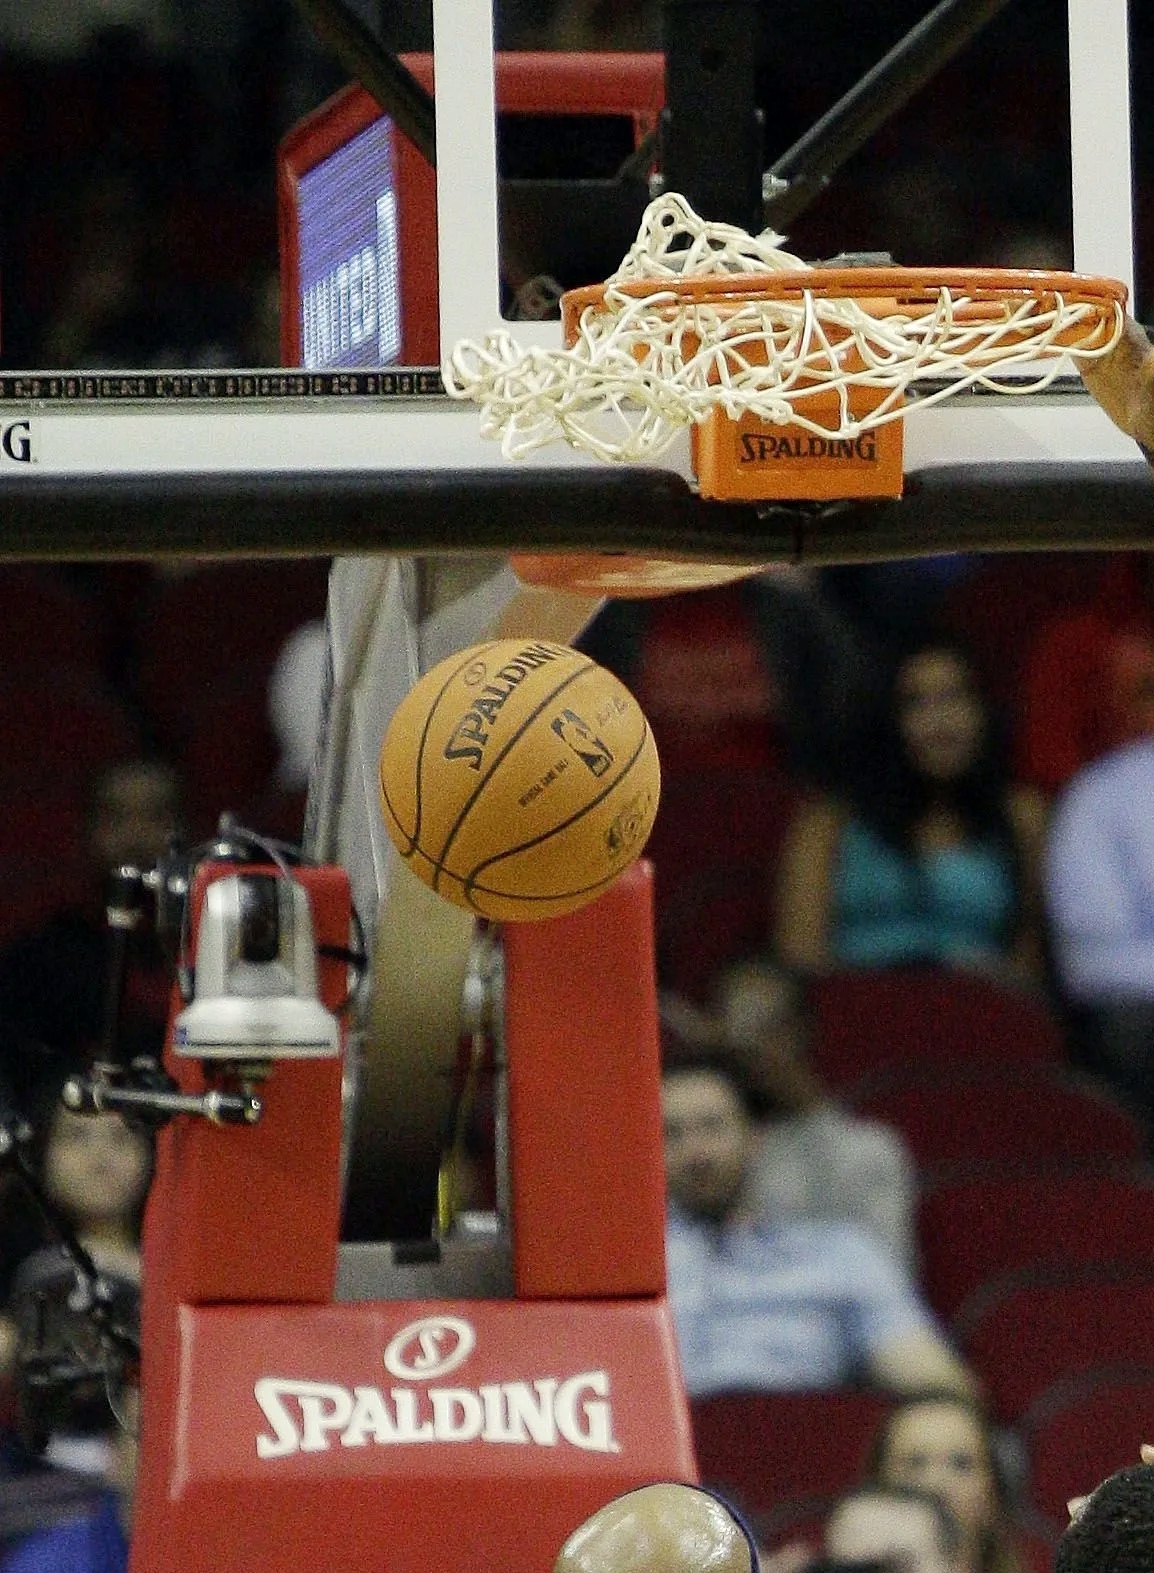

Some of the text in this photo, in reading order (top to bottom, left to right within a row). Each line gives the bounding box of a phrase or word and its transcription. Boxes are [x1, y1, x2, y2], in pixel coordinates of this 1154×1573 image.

[740, 429, 877, 463] SPALDING
[442, 643, 565, 772] SPALDIN
[253, 1368, 622, 1460] SPALDING
